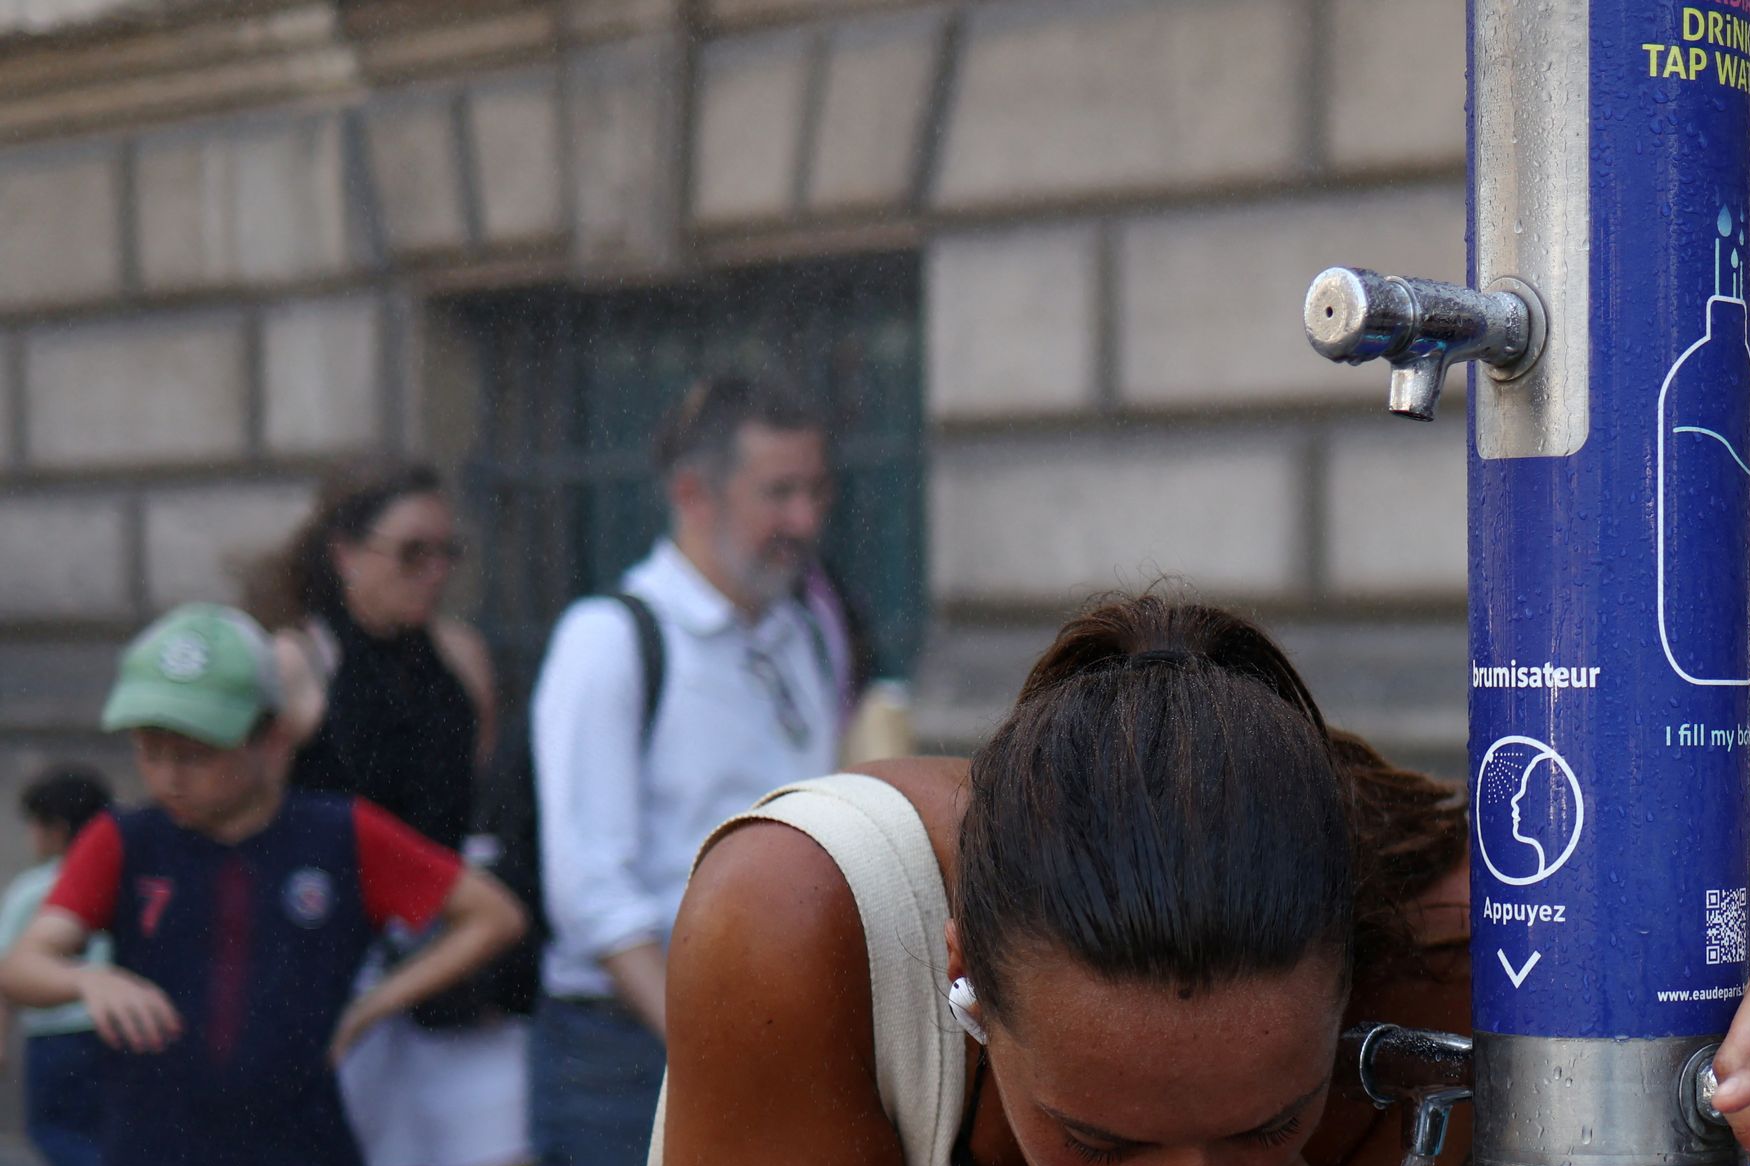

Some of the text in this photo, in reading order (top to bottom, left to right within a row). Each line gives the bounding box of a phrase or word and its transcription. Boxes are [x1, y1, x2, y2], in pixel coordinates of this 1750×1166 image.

[1642, 43, 1708, 80] TAP
[1472, 659, 1600, 689] brumisateur
[1665, 725, 1671, 747] I
[1678, 723, 1705, 747] fill
[1711, 729, 1735, 752] my
[136, 875, 173, 936] 7
[1483, 896, 1566, 927] Appuyez
